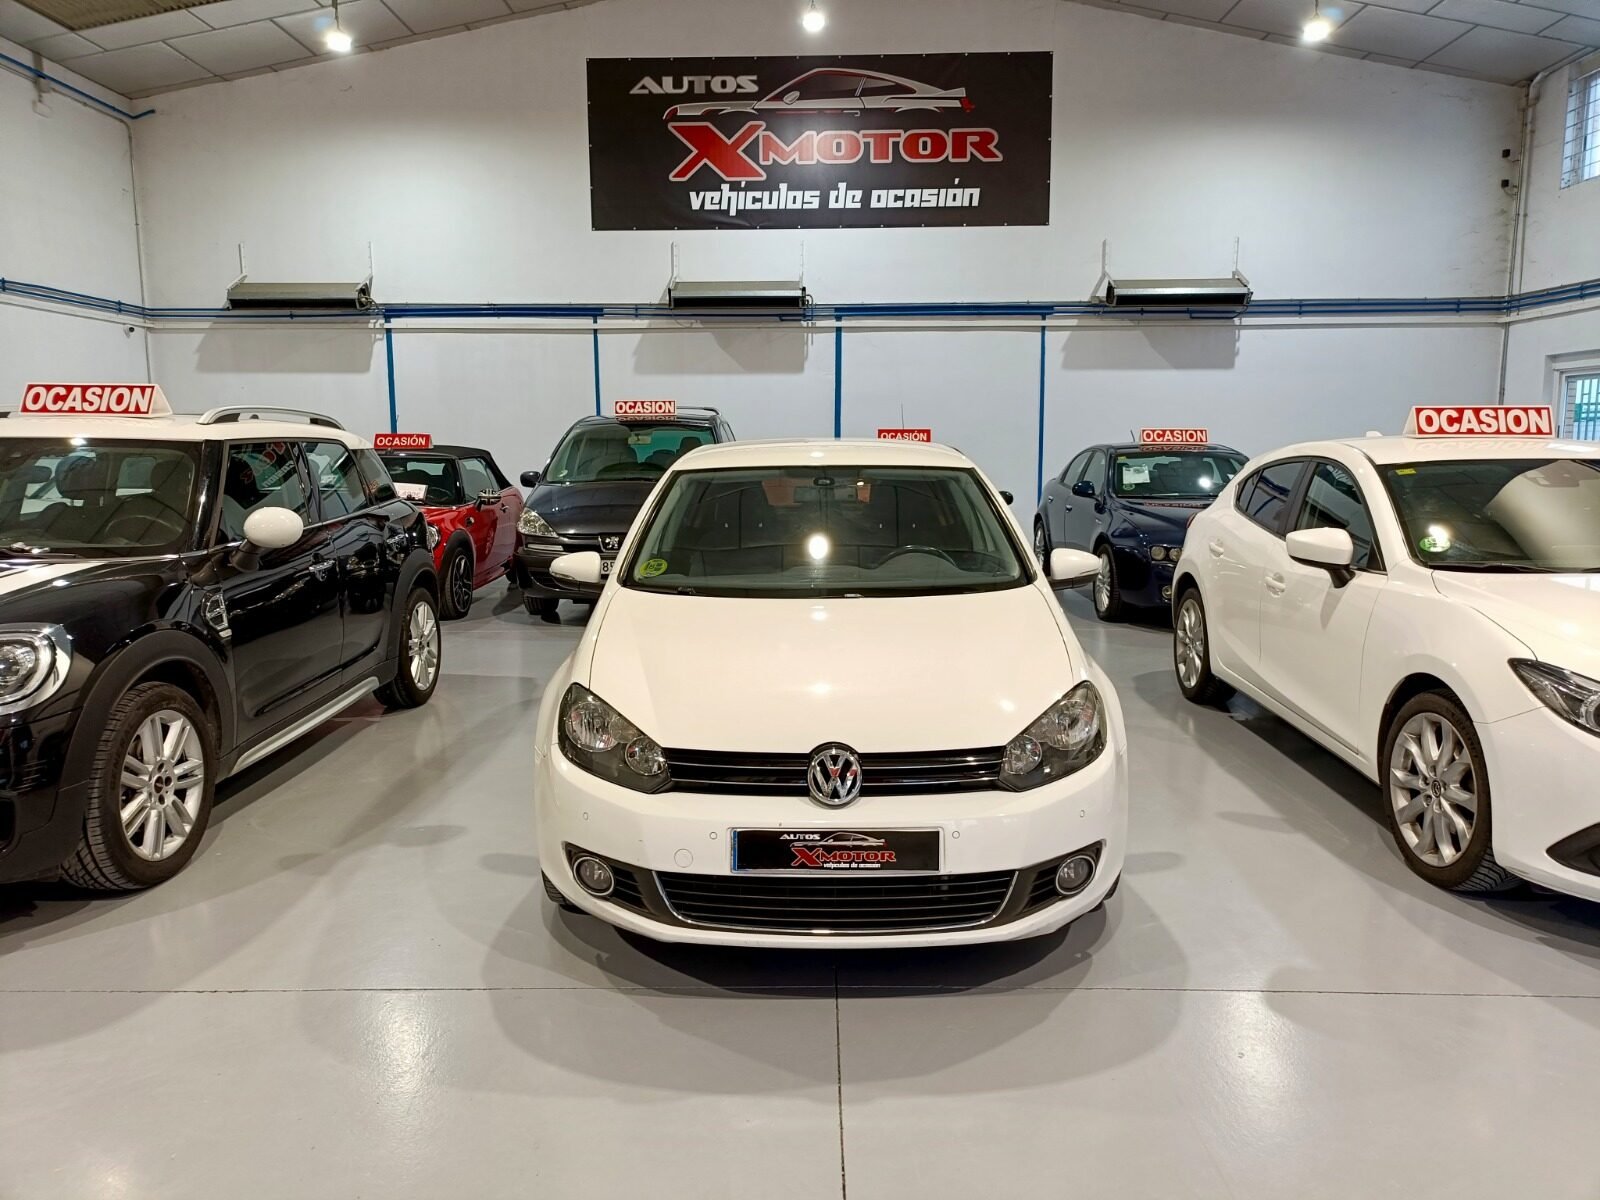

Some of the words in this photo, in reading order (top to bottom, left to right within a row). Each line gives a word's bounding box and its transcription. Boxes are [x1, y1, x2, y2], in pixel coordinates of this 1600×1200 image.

[629, 75, 759, 95] AUTOS
[689, 180, 821, 217] vehículos
[828, 182, 863, 209] de
[870, 177, 981, 208] ocasión
[25, 386, 151, 412] OCASION
[616, 401, 674, 413] OCASION
[1418, 408, 1550, 434] OCASION
[376, 434, 426, 446] OCASIÓN
[880, 430, 928, 441] OCASIÓN
[1143, 430, 1207, 442] OCASION
